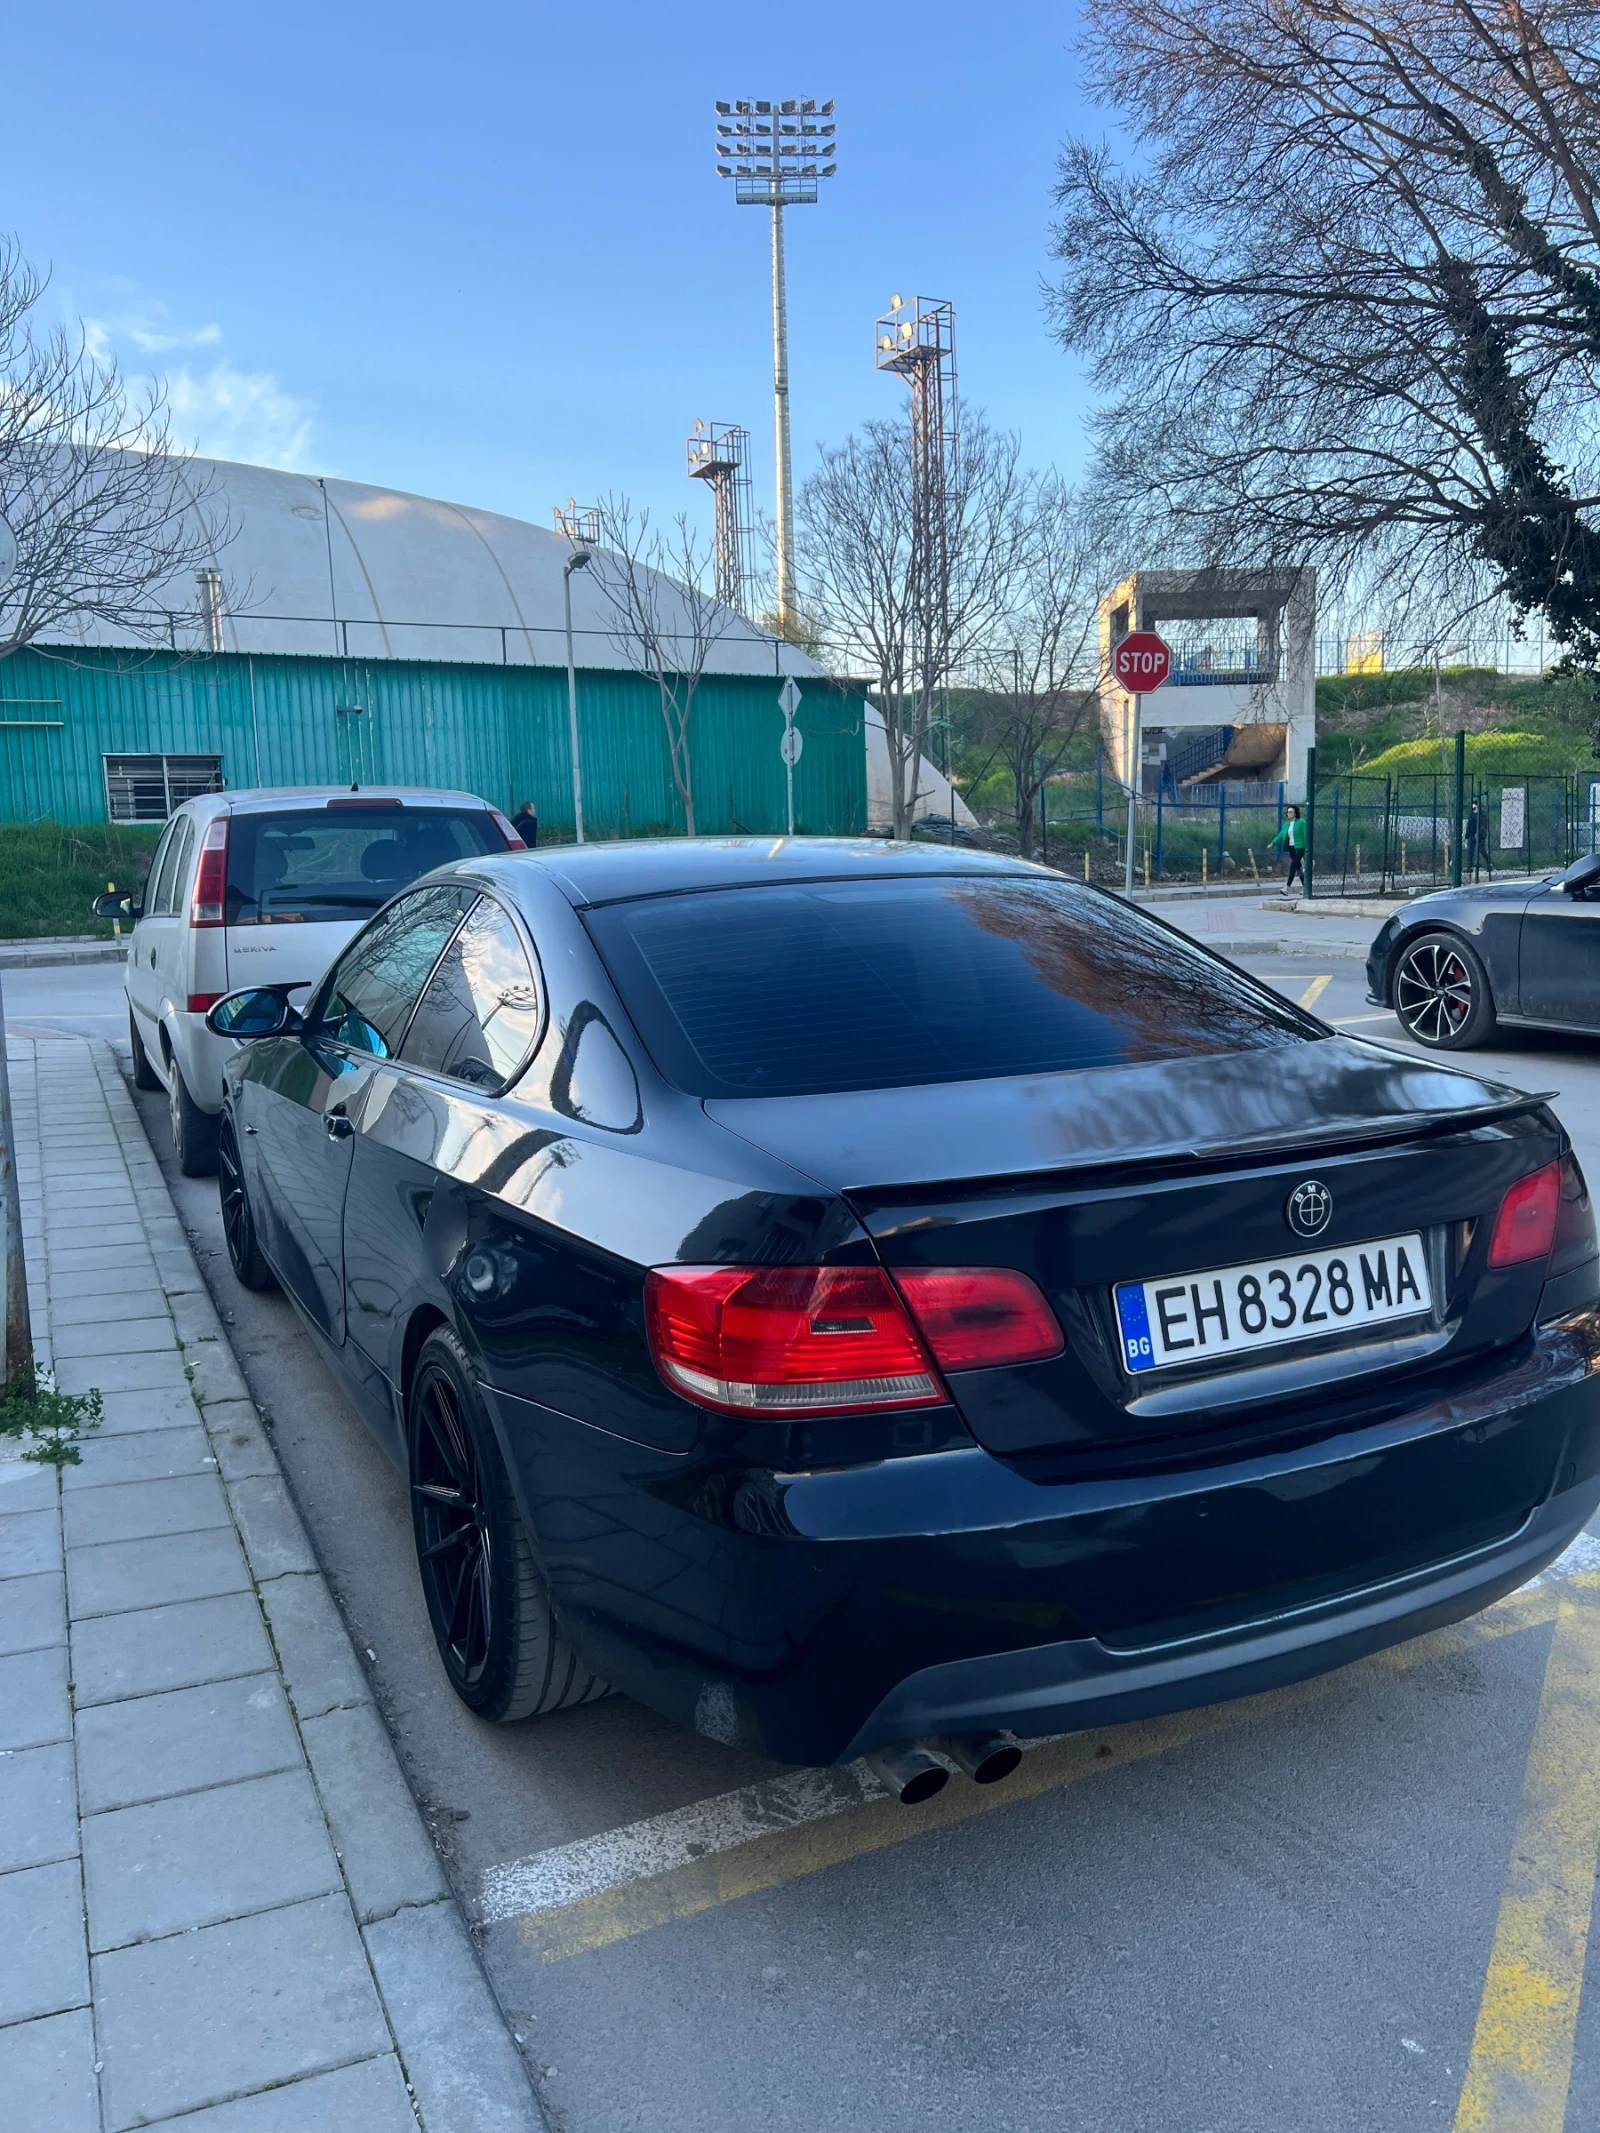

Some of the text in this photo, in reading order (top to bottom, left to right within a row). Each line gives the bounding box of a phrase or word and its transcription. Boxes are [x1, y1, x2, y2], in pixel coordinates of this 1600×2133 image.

[1119, 651, 1165, 673] STOP
[233, 945, 277, 954] MERIVA
[1294, 1184, 1329, 1203] BMW
[1155, 1246, 1421, 1351] EH 8328 MA
[1127, 1336, 1150, 1358] BG
